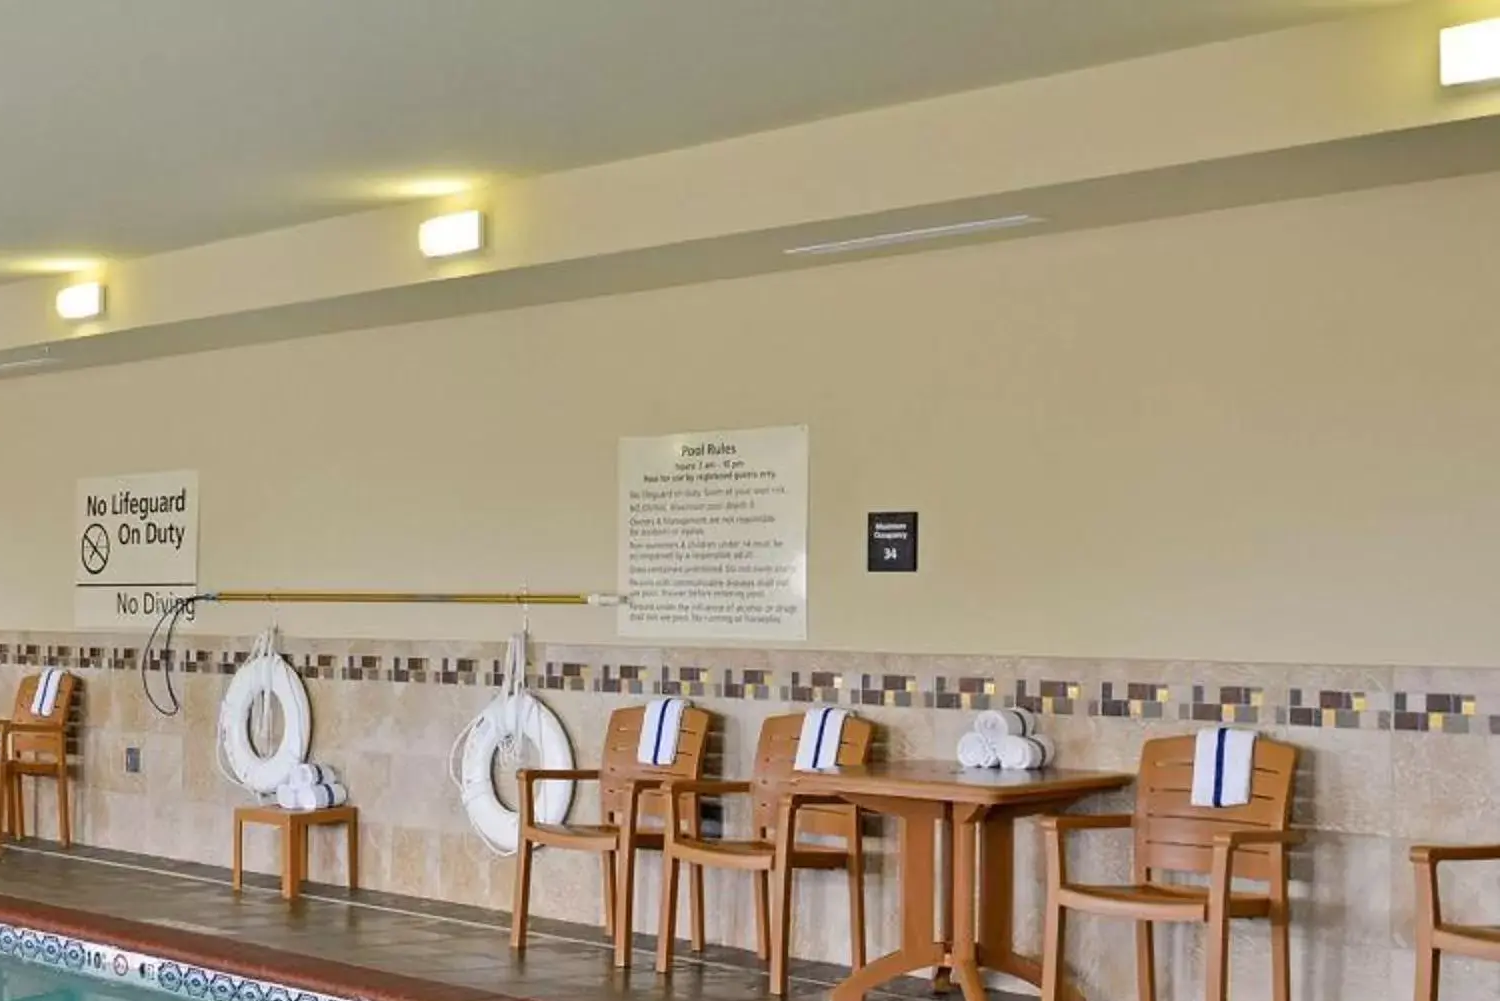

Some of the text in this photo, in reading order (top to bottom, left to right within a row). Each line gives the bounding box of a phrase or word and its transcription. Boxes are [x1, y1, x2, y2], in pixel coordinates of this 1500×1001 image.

[681, 442, 737, 457] Pool Rules
[87, 487, 186, 520] No Lifeguard
[118, 522, 185, 550] On Duty
[883, 547, 897, 560] 34
[117, 592, 196, 621] No Diving
